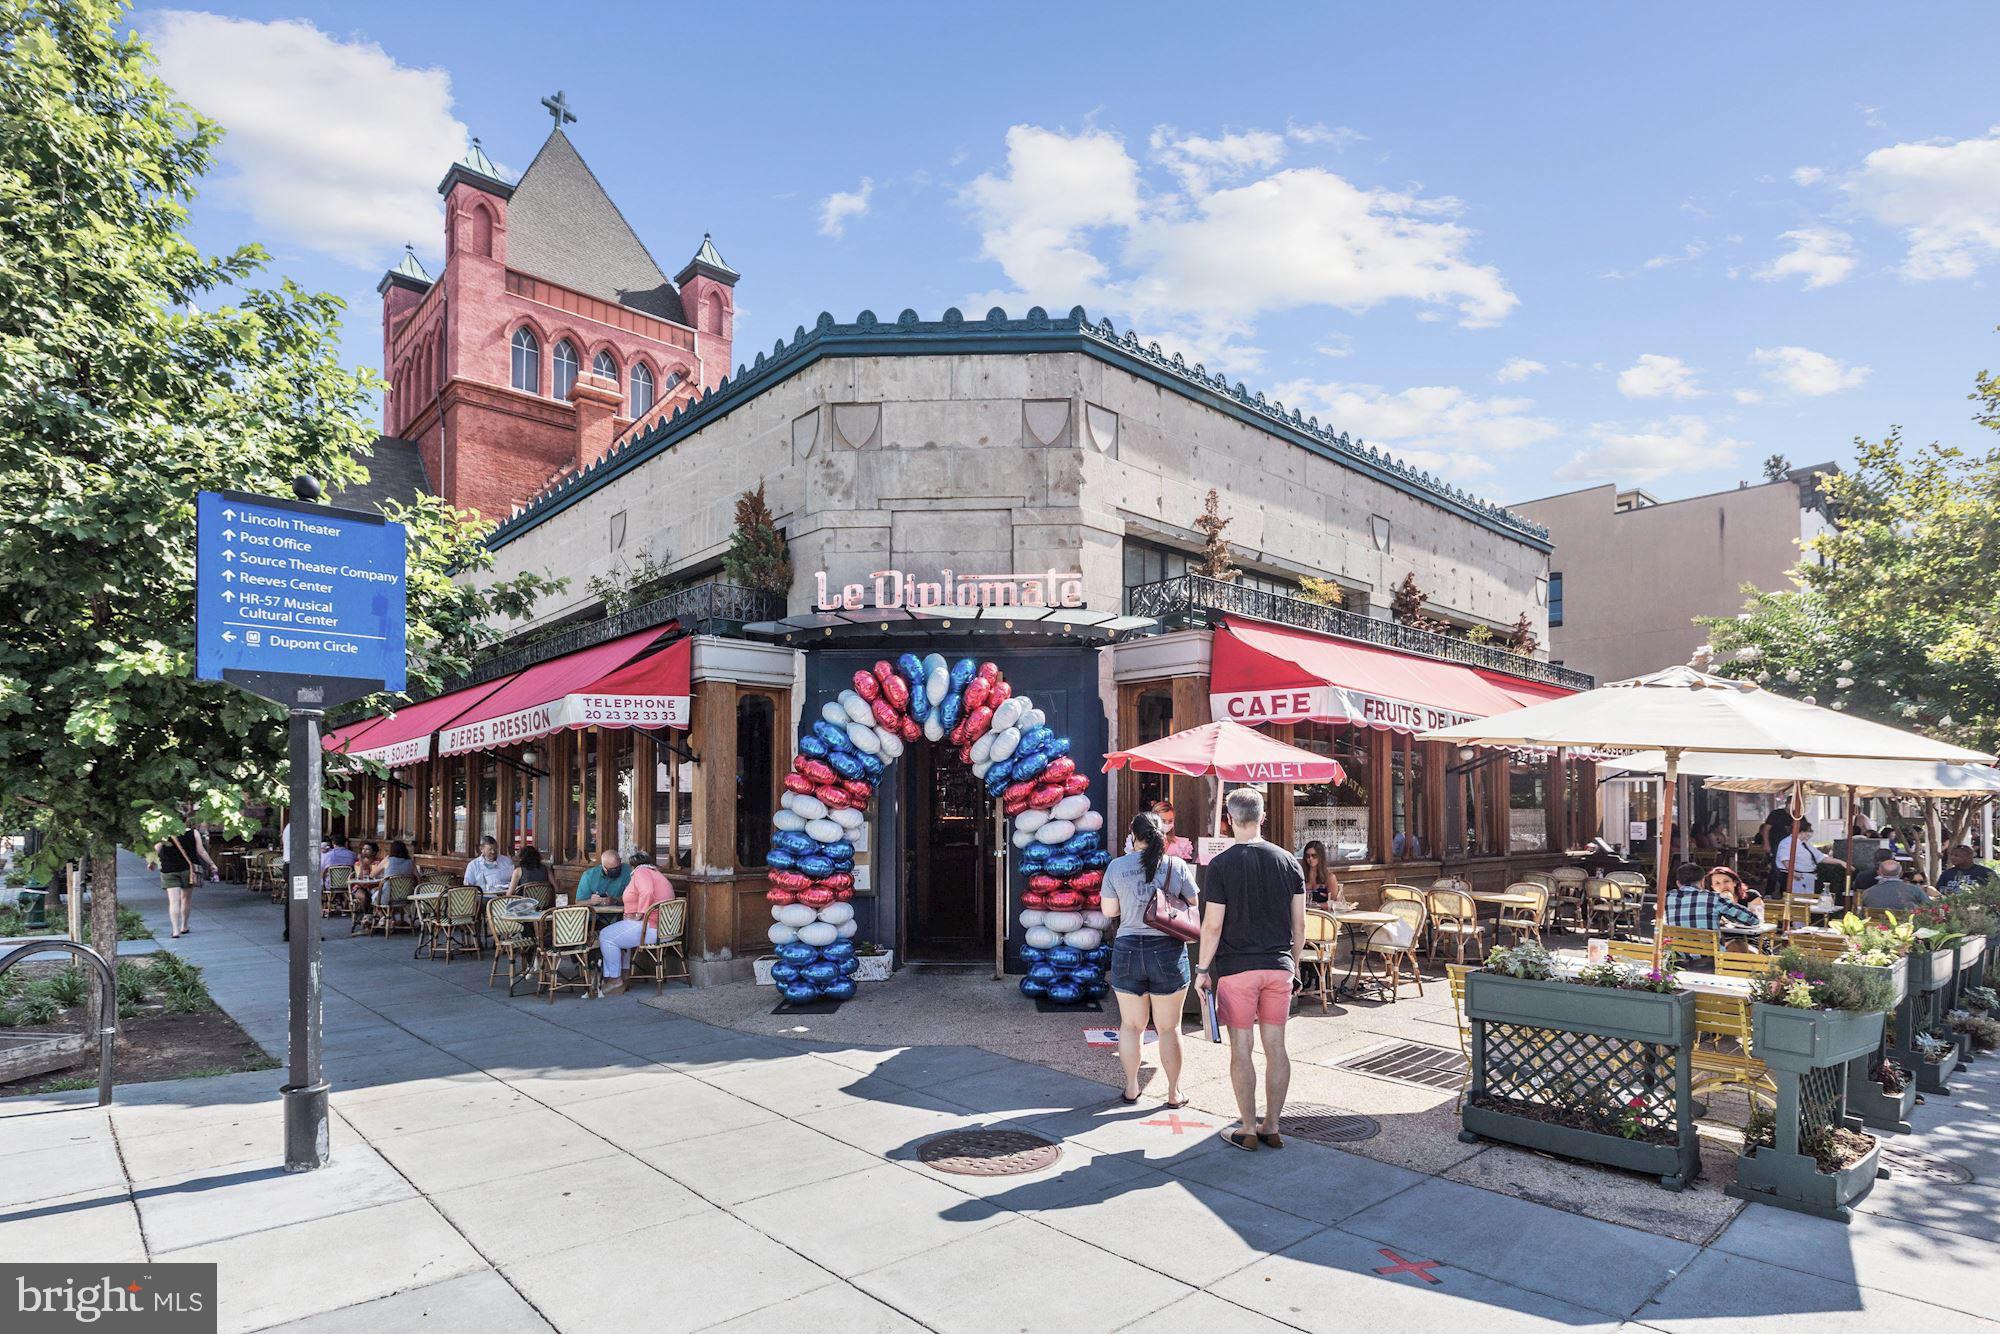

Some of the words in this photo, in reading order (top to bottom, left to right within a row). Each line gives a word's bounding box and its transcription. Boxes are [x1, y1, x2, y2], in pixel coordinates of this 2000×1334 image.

[241, 512, 289, 530] Lincoln
[292, 519, 341, 537] Theater
[240, 532, 269, 546] Post
[273, 536, 312, 553] Office
[240, 552, 287, 569] Source
[289, 558, 338, 575] Theater
[340, 565, 399, 585] Company
[240, 572, 287, 588] Reeves
[290, 579, 333, 593] Center
[815, 571, 864, 610] Le
[869, 567, 1082, 610] Diplomate
[240, 592, 280, 606] HR-57
[284, 597, 333, 613] Musical
[240, 606, 292, 622] Cultural
[296, 613, 338, 627] Center
[270, 635, 320, 650] Dupont
[323, 640, 358, 654] Circle
[583, 698, 675, 709] TELEPHONE
[1227, 692, 1311, 718] CAFE
[1363, 698, 1421, 727] FRUITS
[1427, 710, 1445, 730] DE
[585, 710, 601, 719] 20
[606, 711, 620, 720] 23
[625, 711, 639, 720] 32
[643, 711, 658, 720] 33
[662, 711, 676, 720] 33
[450, 725, 485, 749] BIERES
[492, 708, 551, 740] PRESSION
[391, 743, 419, 761] SOUPER
[1244, 762, 1305, 778] VALET
